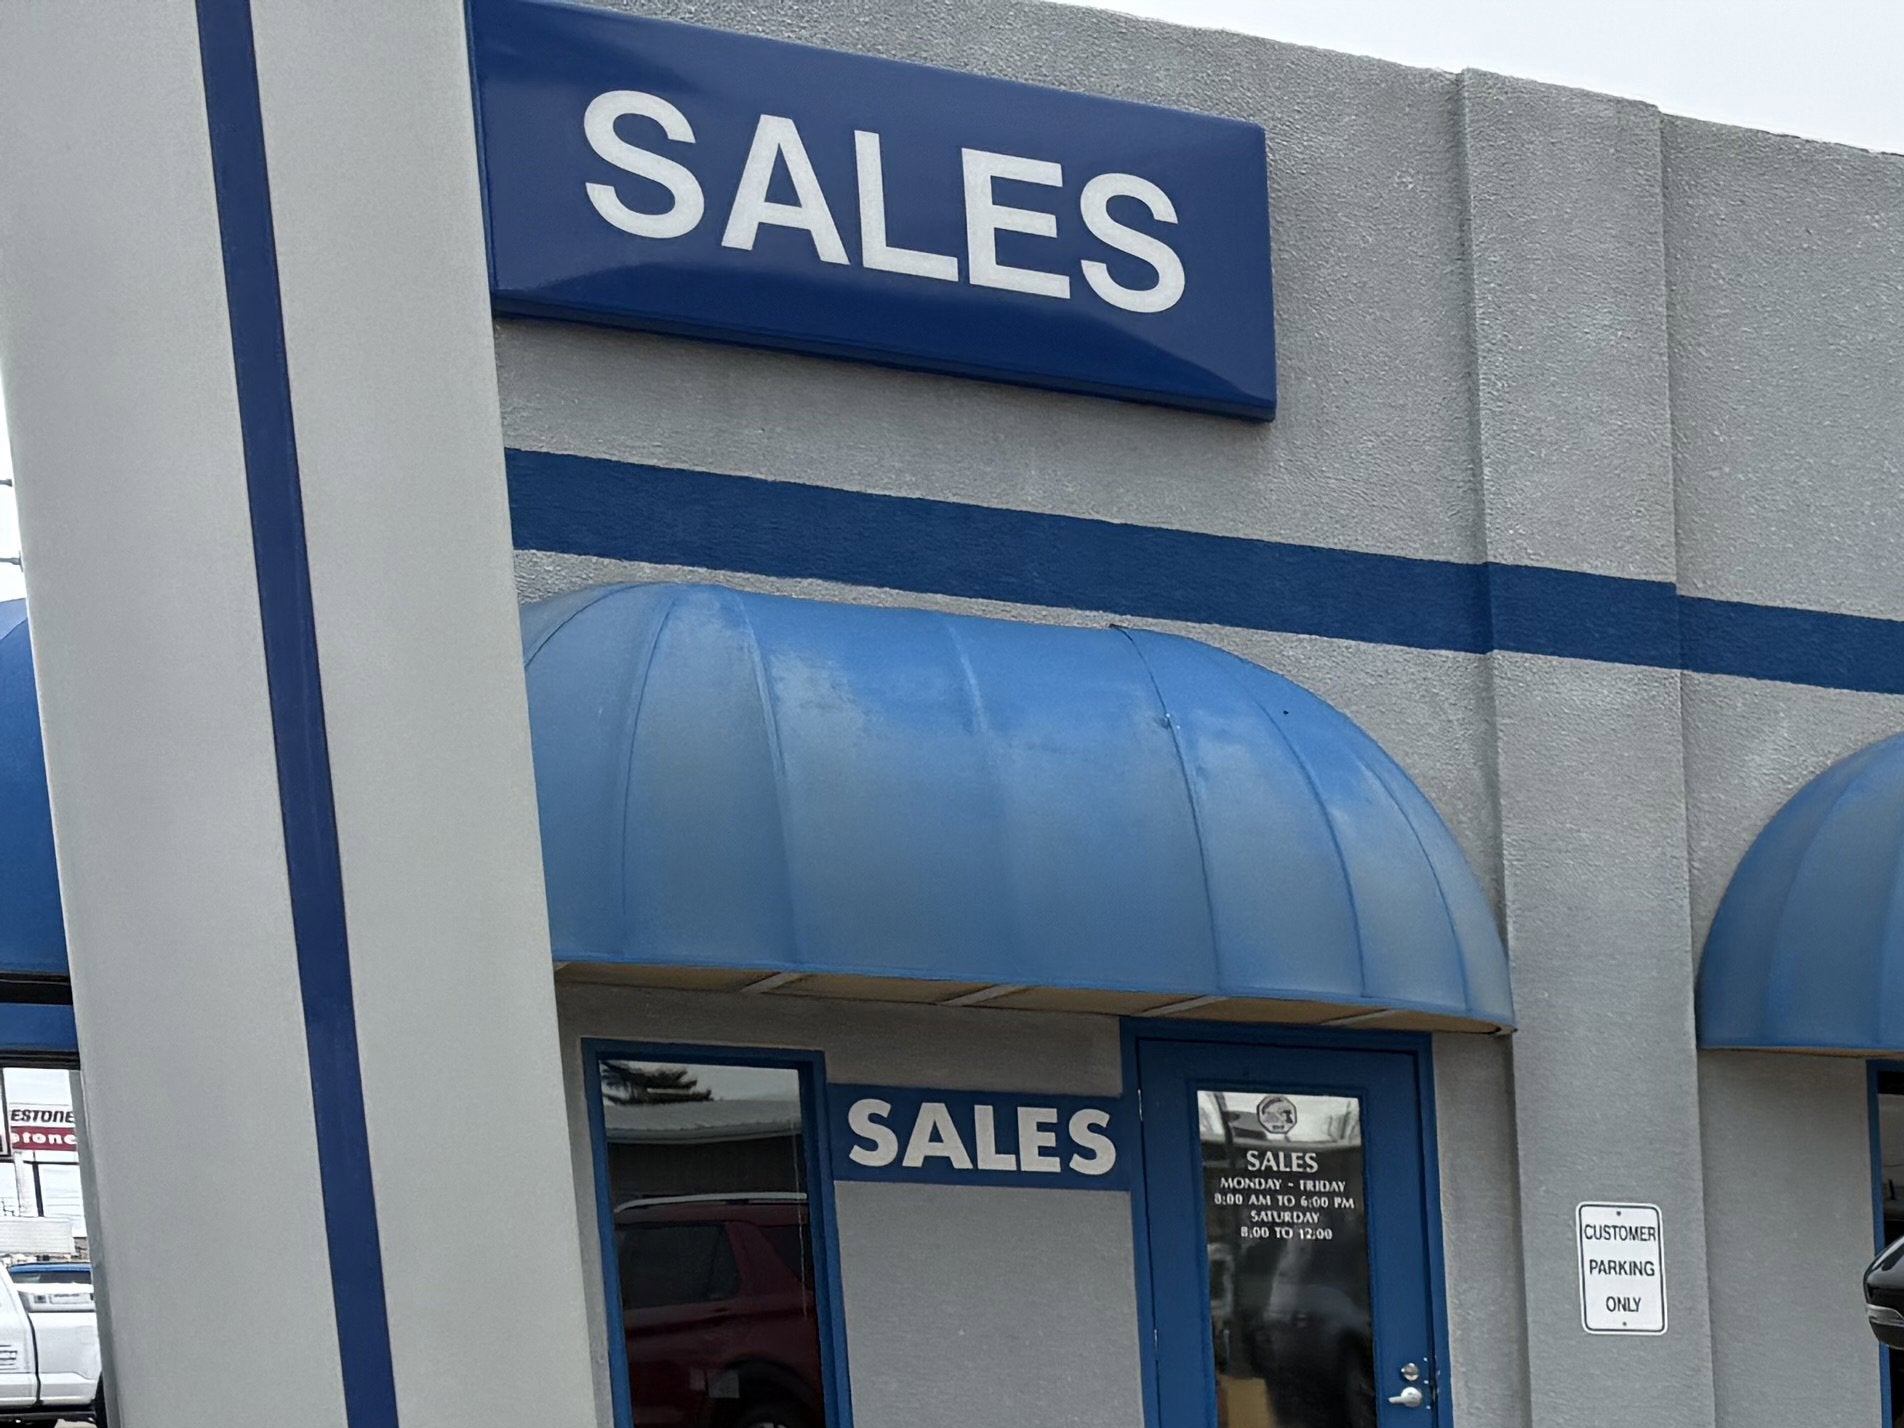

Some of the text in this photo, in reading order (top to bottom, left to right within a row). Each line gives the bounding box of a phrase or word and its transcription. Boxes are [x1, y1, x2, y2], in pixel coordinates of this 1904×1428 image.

[584, 90, 1186, 313] SALES
[848, 1098, 1117, 1176] SALES
[1246, 1150, 1319, 1173] SALES
[1220, 1176, 1282, 1190] MONDAY
[1214, 1193, 1355, 1209] 8:00 AM TO 6:00 PM
[1250, 1209, 1320, 1223] SATURDAY
[1274, 1226, 1294, 1239] TO
[1299, 1227, 1333, 1240] 12:00
[1584, 1224, 1656, 1241] CUSTOMER
[1589, 1259, 1656, 1277] PARKING
[1605, 1296, 1642, 1312] ONLY
